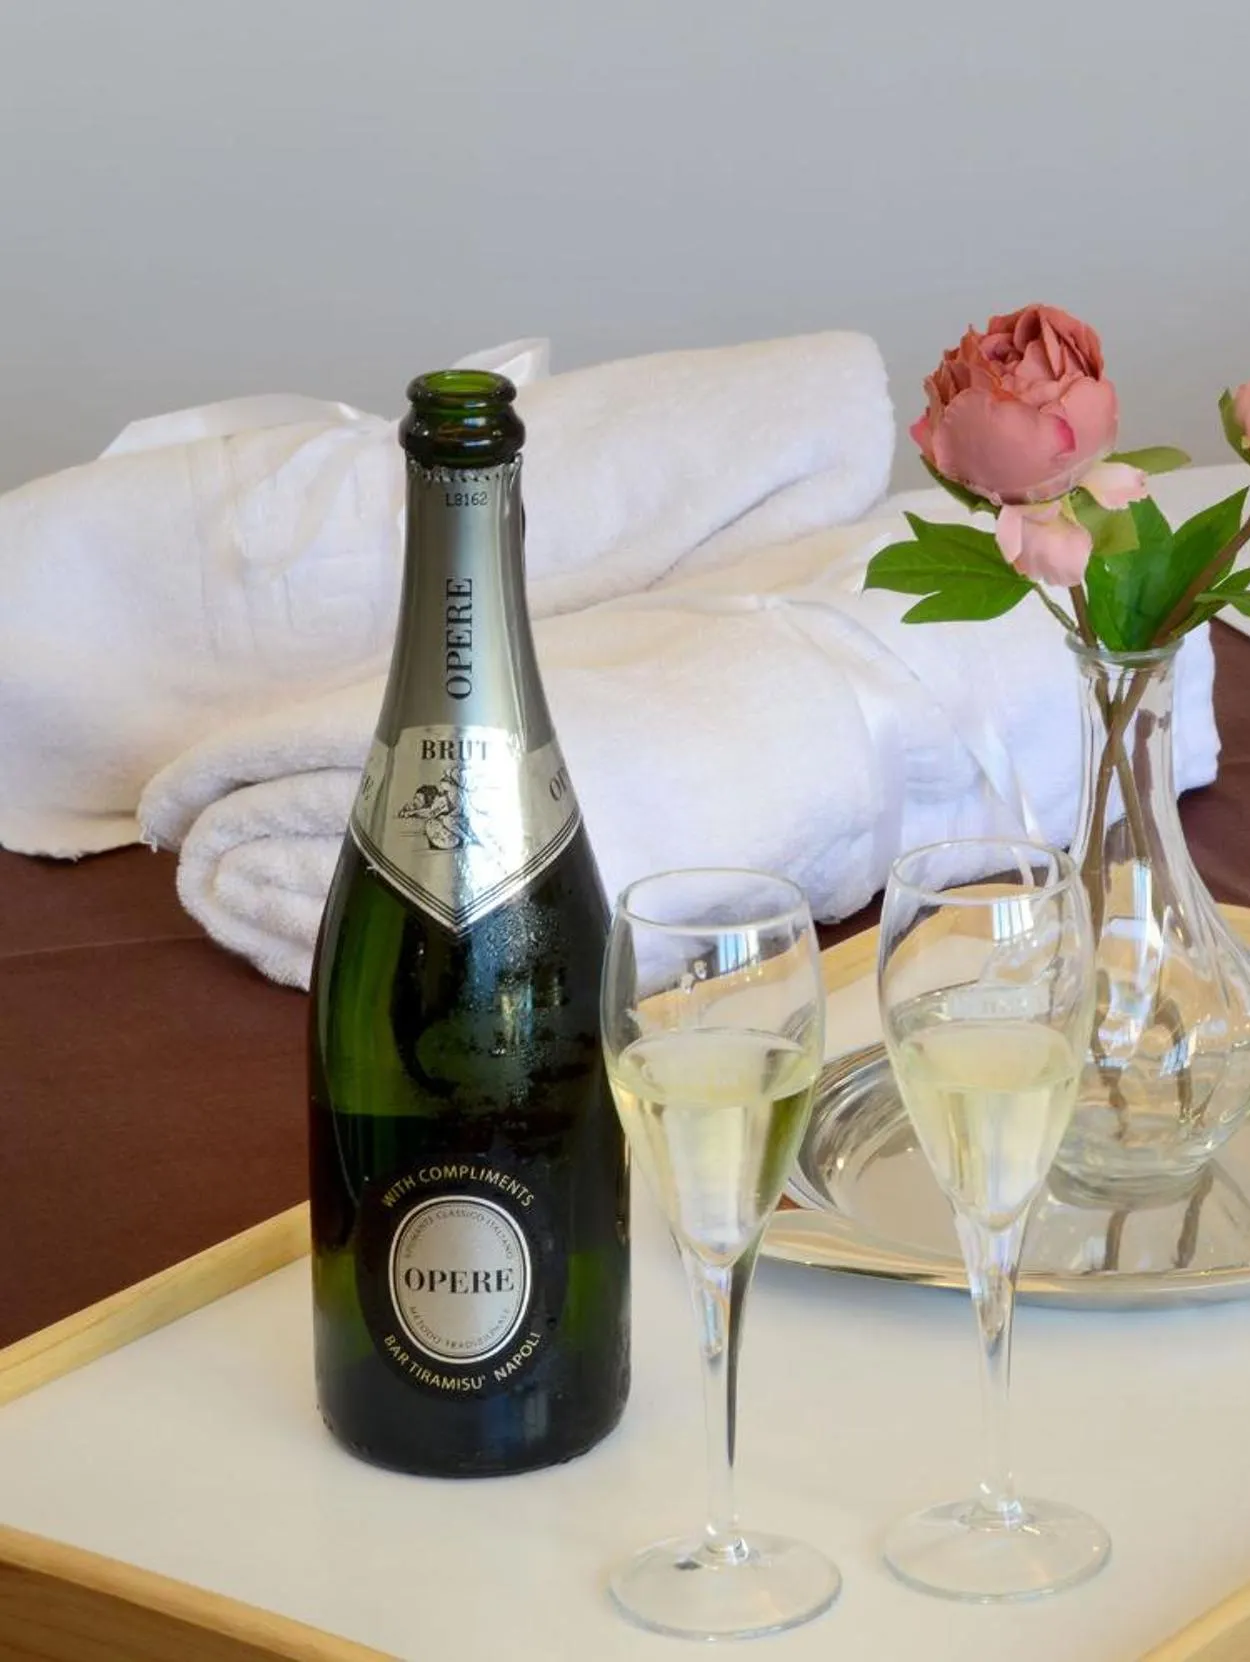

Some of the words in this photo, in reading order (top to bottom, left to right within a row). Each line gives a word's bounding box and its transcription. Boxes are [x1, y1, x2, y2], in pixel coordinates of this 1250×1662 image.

[446, 491, 488, 507] L8162
[446, 578, 473, 700] OPERE
[421, 738, 491, 760] BRUT
[382, 1176, 416, 1208] WITH
[418, 1165, 535, 1208] COMPLIMENTS
[404, 1267, 515, 1295] OPERE
[383, 1333, 409, 1366] BAR
[493, 1331, 542, 1382] NAPOLI
